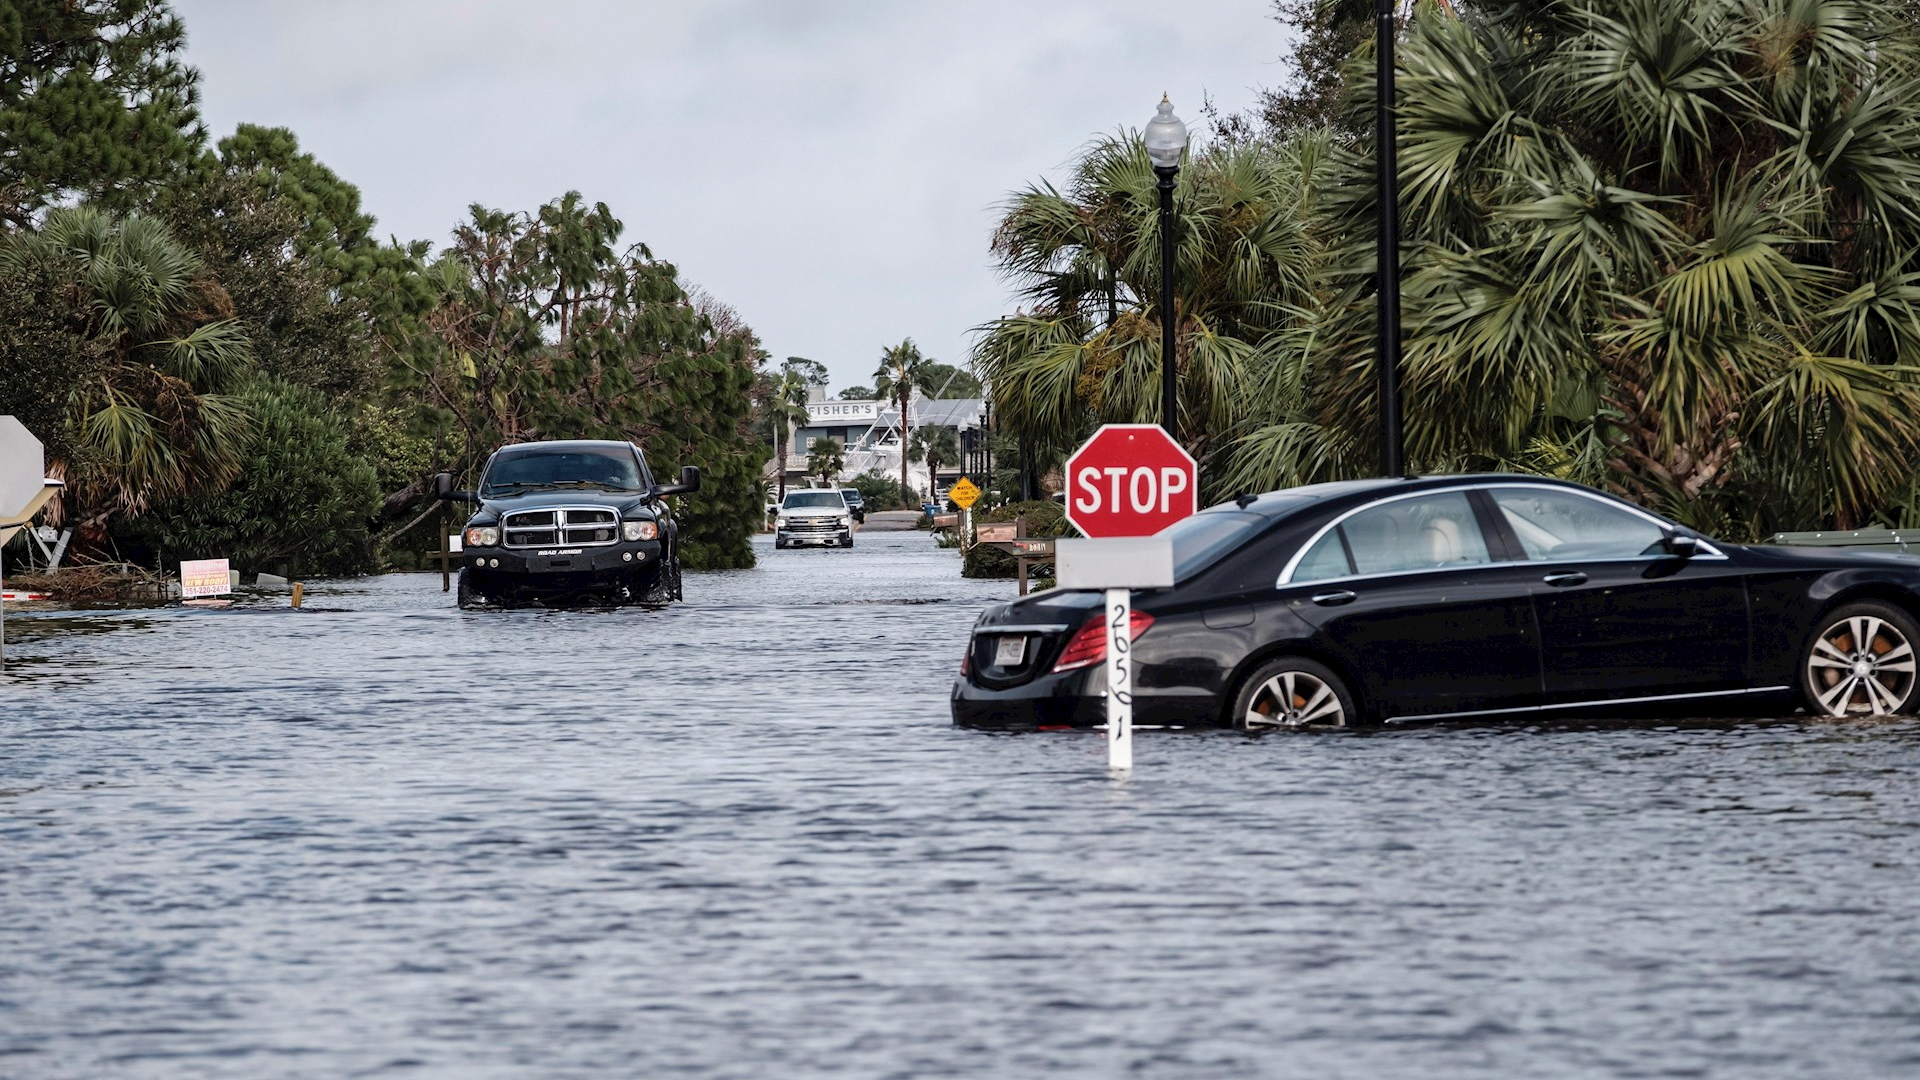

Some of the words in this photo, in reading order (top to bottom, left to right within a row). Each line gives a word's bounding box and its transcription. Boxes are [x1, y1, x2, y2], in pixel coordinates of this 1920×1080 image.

[808, 405, 872, 415] FISHER'S
[1076, 466, 1187, 514] STOP
[184, 579, 204, 587] NEW
[185, 585, 228, 594] 251-220-2474
[1111, 604, 1132, 741] 26561
